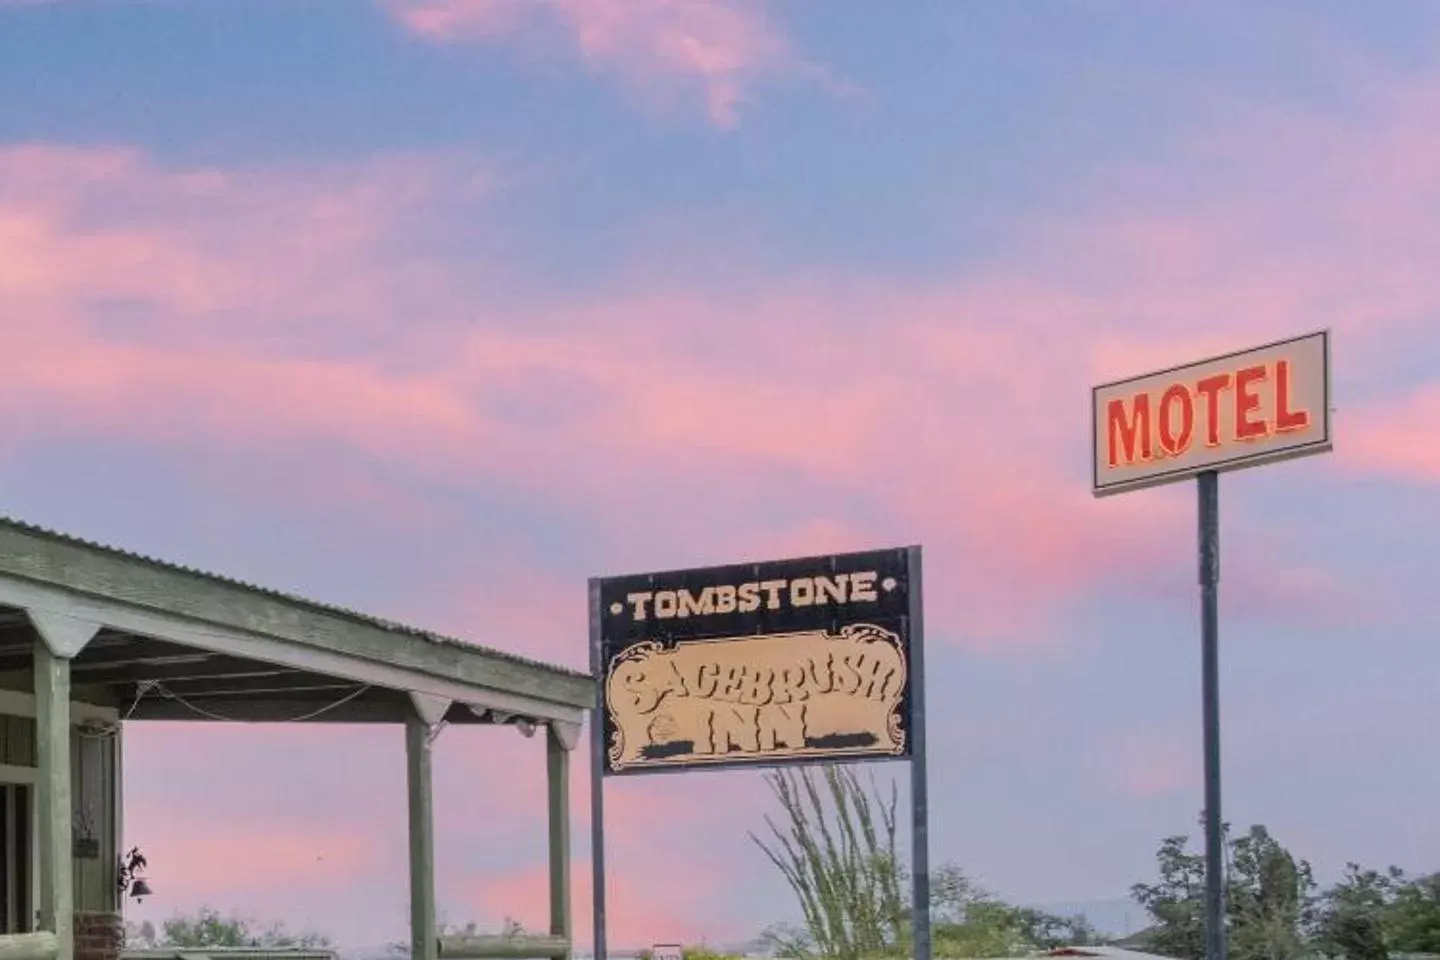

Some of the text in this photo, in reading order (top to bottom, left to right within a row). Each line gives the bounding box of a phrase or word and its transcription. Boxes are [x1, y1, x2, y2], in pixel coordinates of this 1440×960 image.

[1107, 359, 1310, 468] MOTEL
[627, 571, 878, 621] TOMBSTONE
[623, 653, 898, 715] SAGEBRUSH
[692, 704, 808, 755] INN
